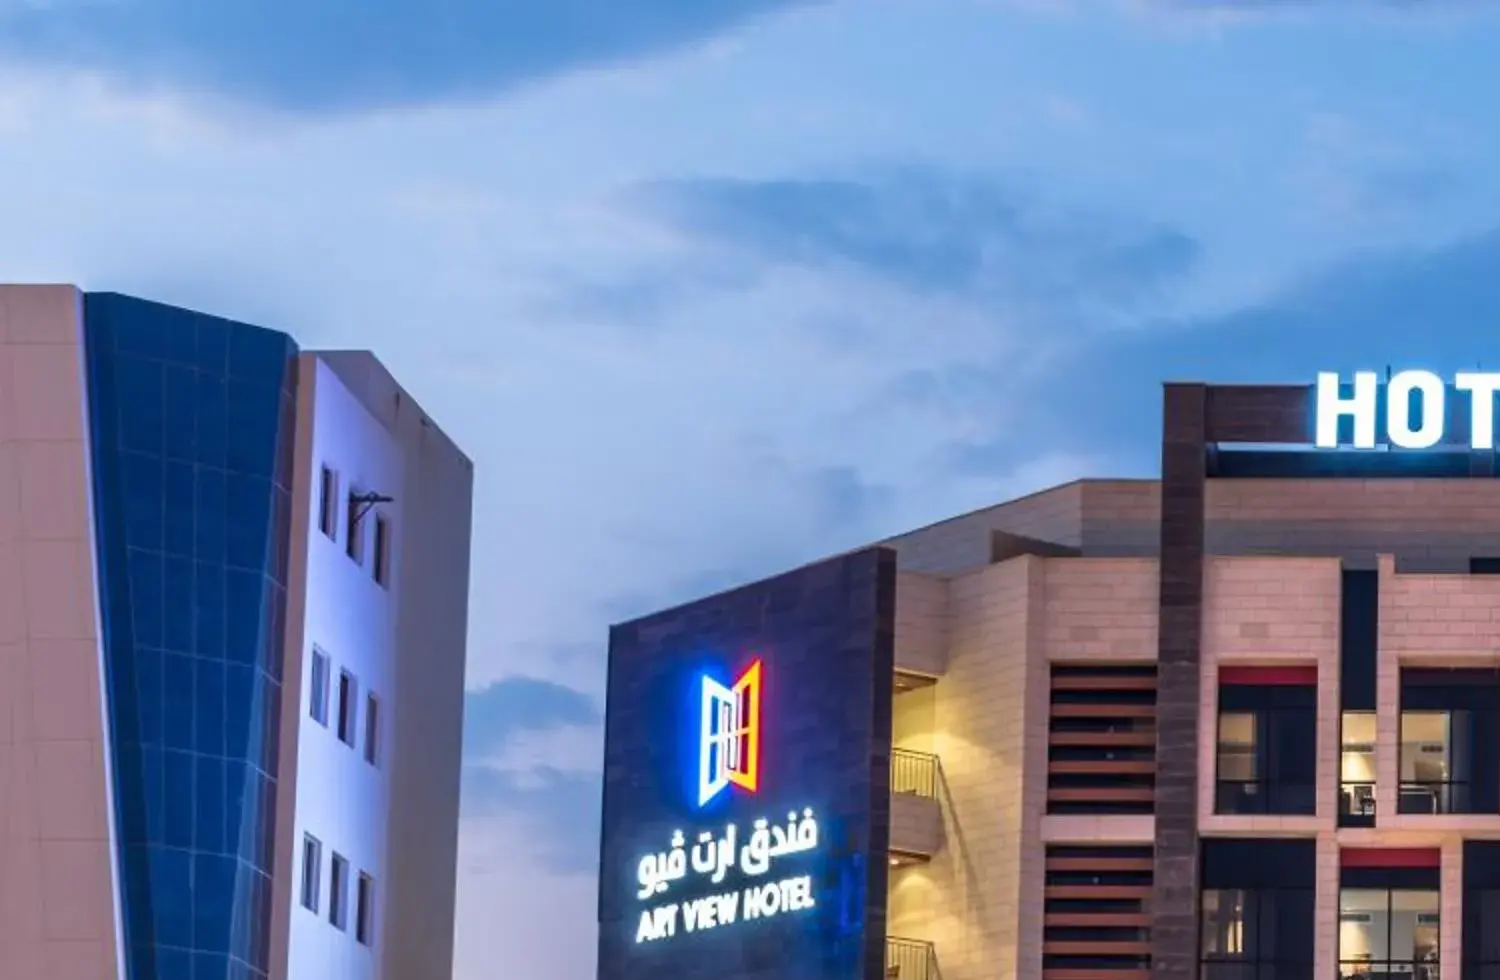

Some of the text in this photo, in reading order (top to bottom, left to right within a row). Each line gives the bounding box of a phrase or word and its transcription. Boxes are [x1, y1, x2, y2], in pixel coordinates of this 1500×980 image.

[691, 824, 735, 883] ارت
[740, 808, 818, 875] فندق
[636, 876, 815, 943] ART VIEW HOTEL
